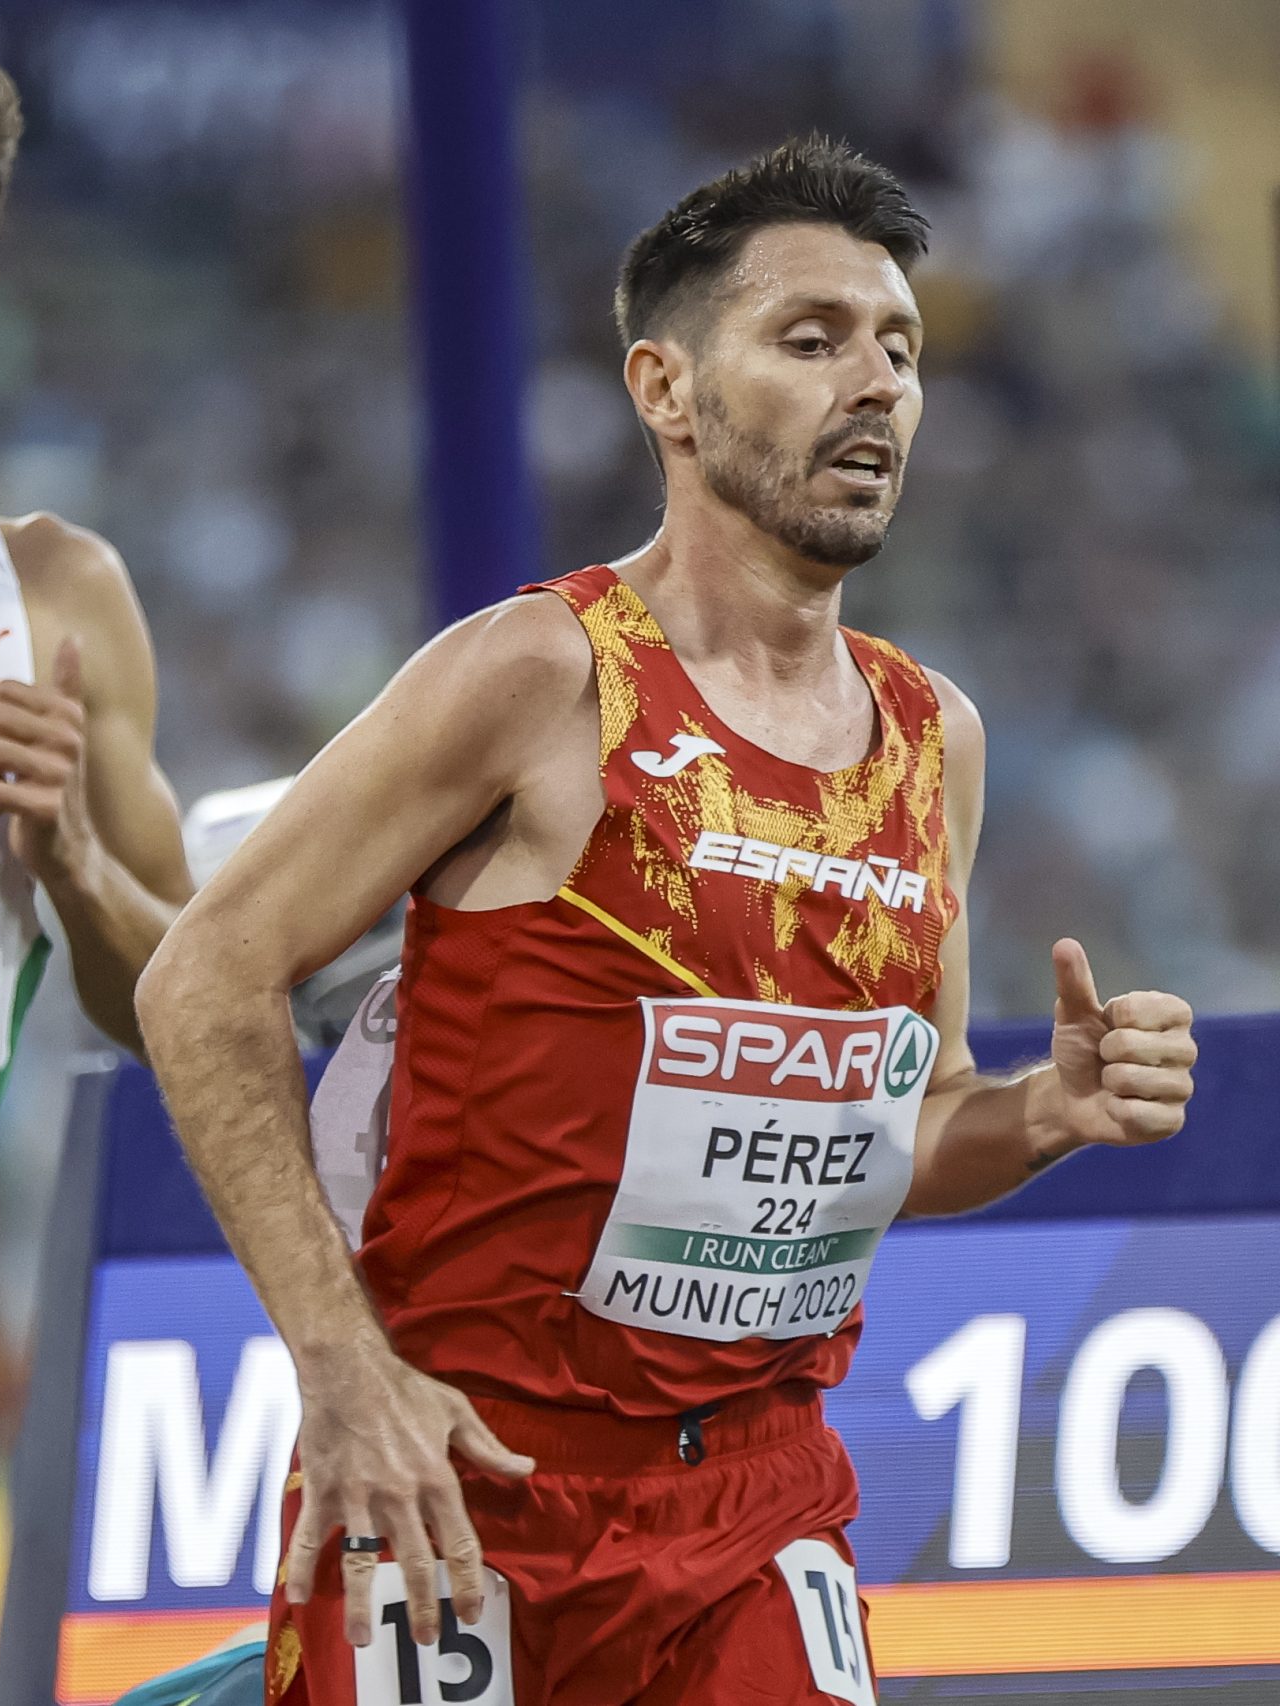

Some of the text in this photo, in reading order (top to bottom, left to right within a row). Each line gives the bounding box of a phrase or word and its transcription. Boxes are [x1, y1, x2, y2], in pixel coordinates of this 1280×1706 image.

[688, 831, 928, 913] ESPAÑA
[658, 1015, 882, 1090] SPAR
[702, 1120, 874, 1185] PÉREZ
[751, 1198, 817, 1235] 224
[682, 1236, 830, 1271] I RUN CLEAN
[604, 1270, 856, 1327] MUNICH 2022
[903, 1306, 1280, 1569] 10
[380, 1597, 493, 1706] 15
